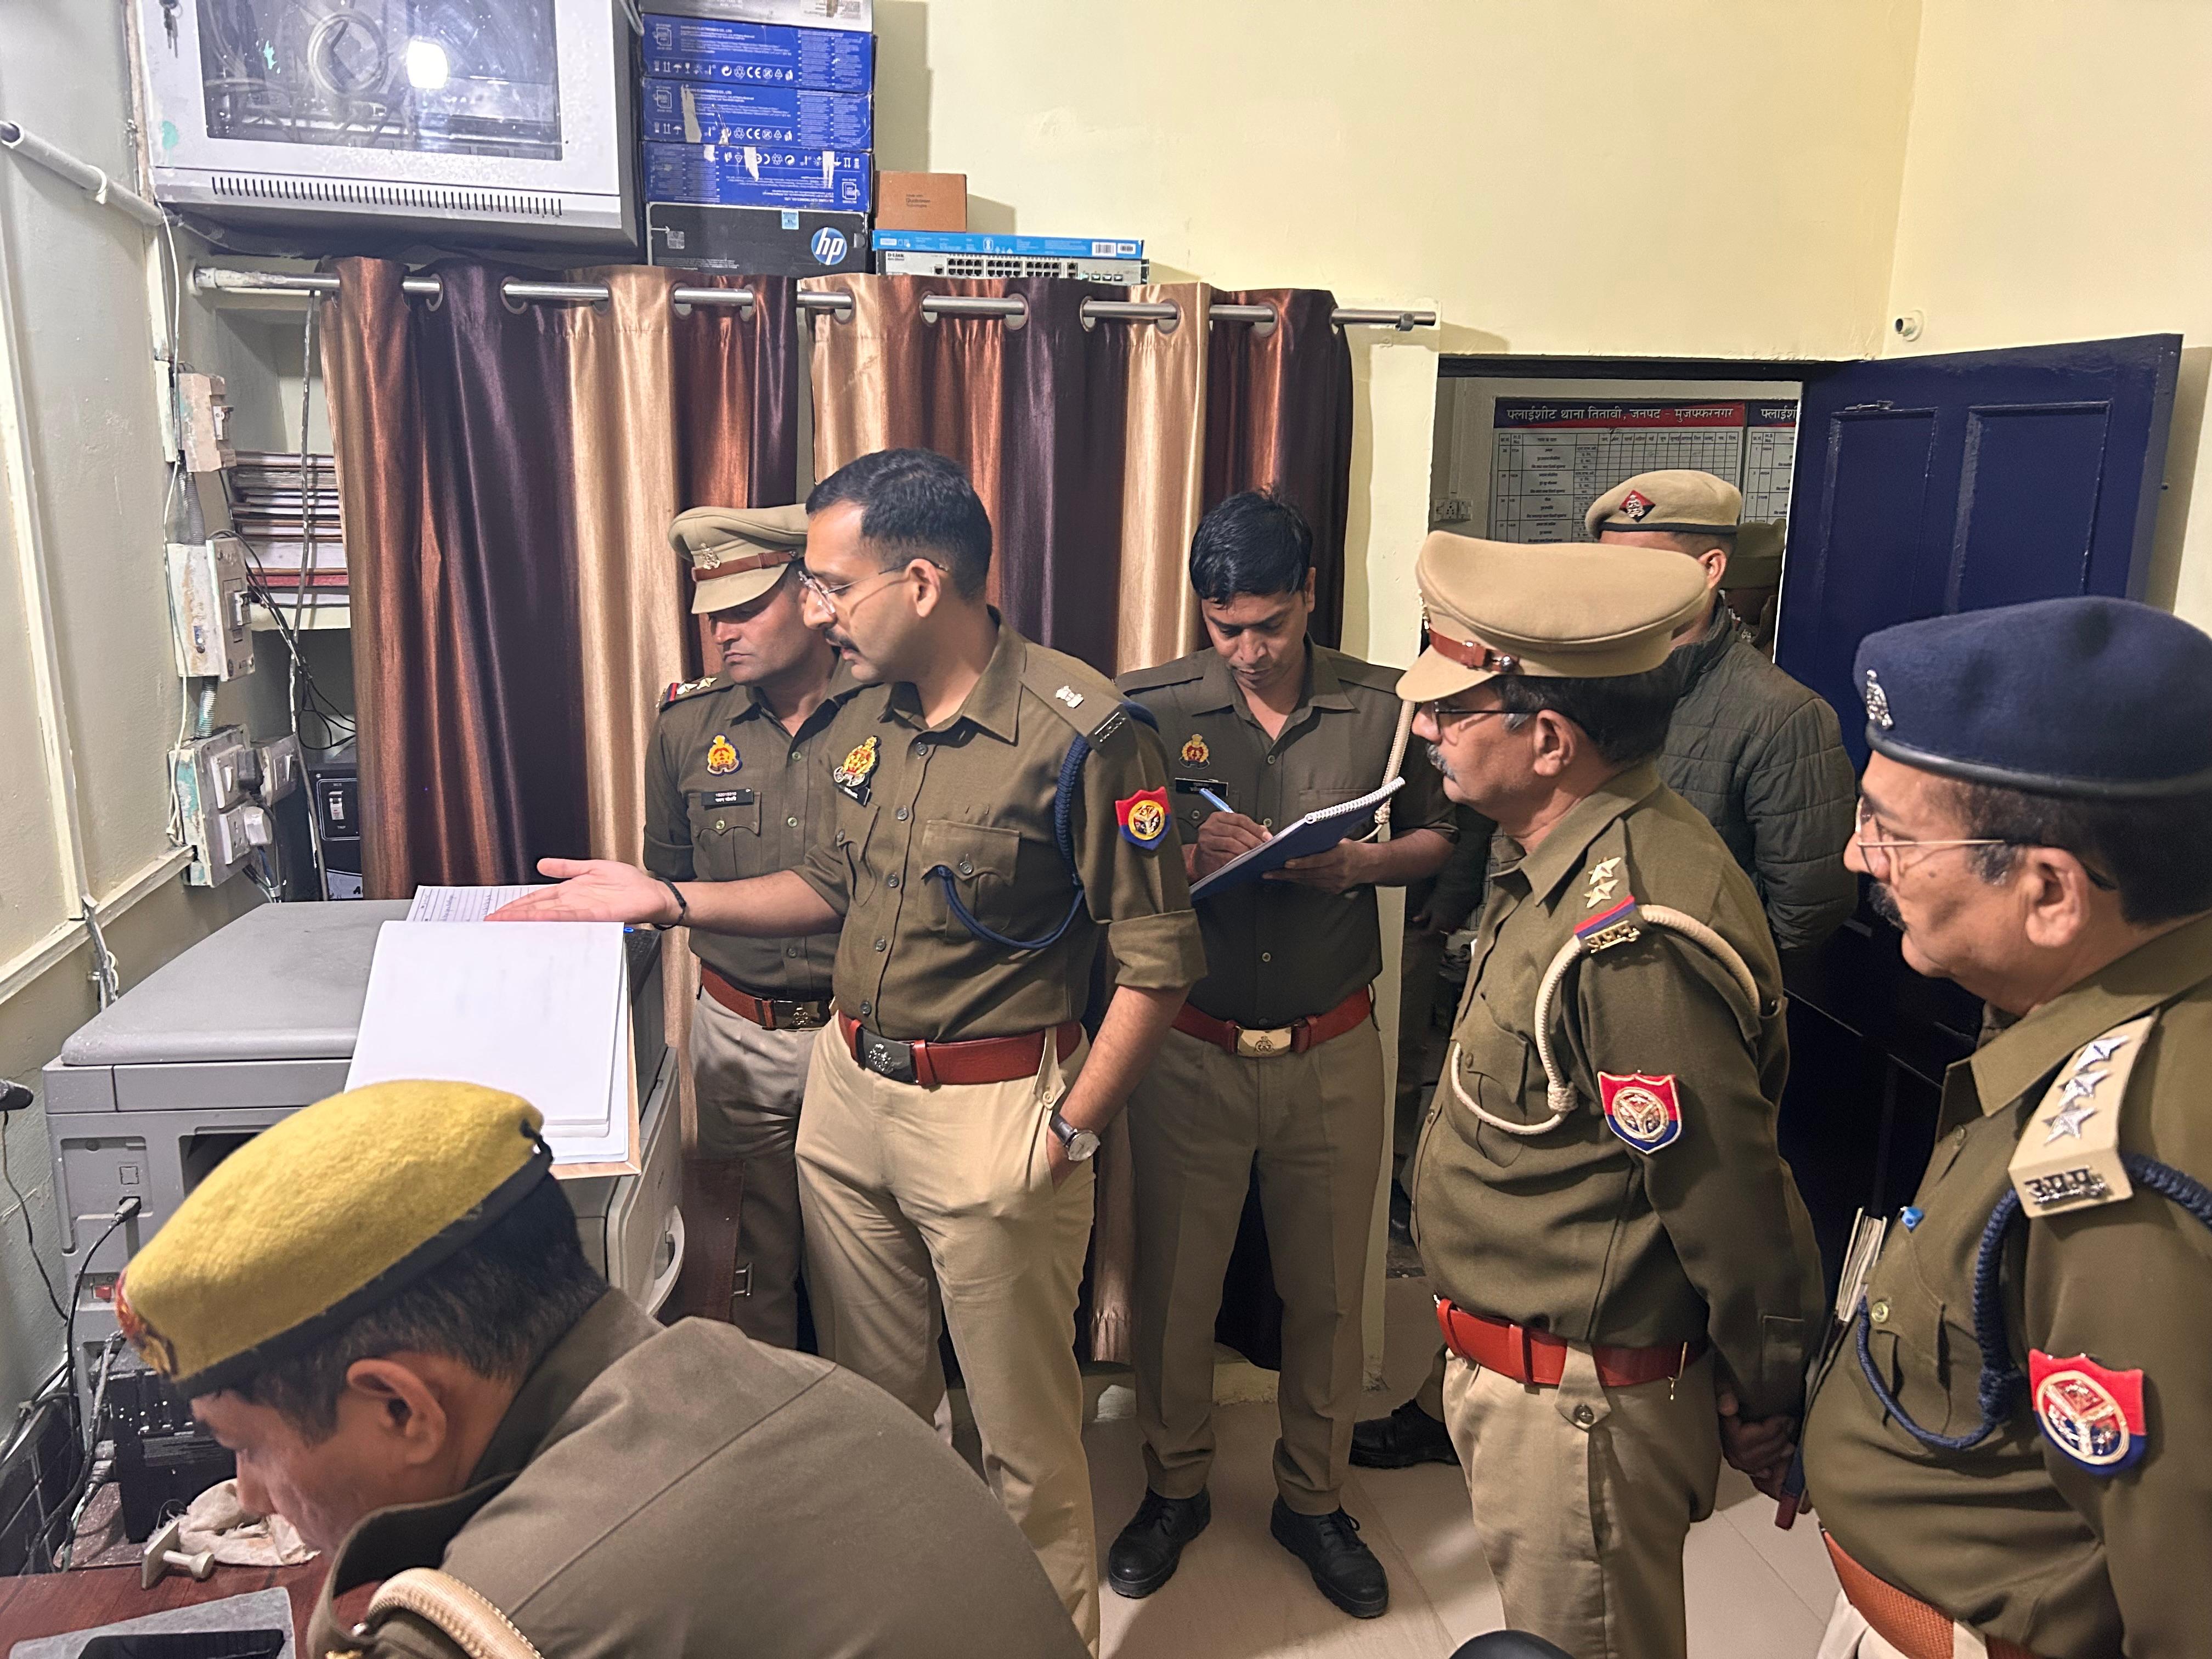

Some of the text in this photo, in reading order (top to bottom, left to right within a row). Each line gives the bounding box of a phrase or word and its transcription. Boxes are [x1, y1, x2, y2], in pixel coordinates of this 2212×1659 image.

[816, 227, 844, 266] hp
[1506, 405, 1558, 422] फ्लाईशीट
[1560, 409, 1585, 419] थाना
[1629, 409, 1661, 419] जनपद
[1674, 408, 1734, 422] मुजफ्फरनगर
